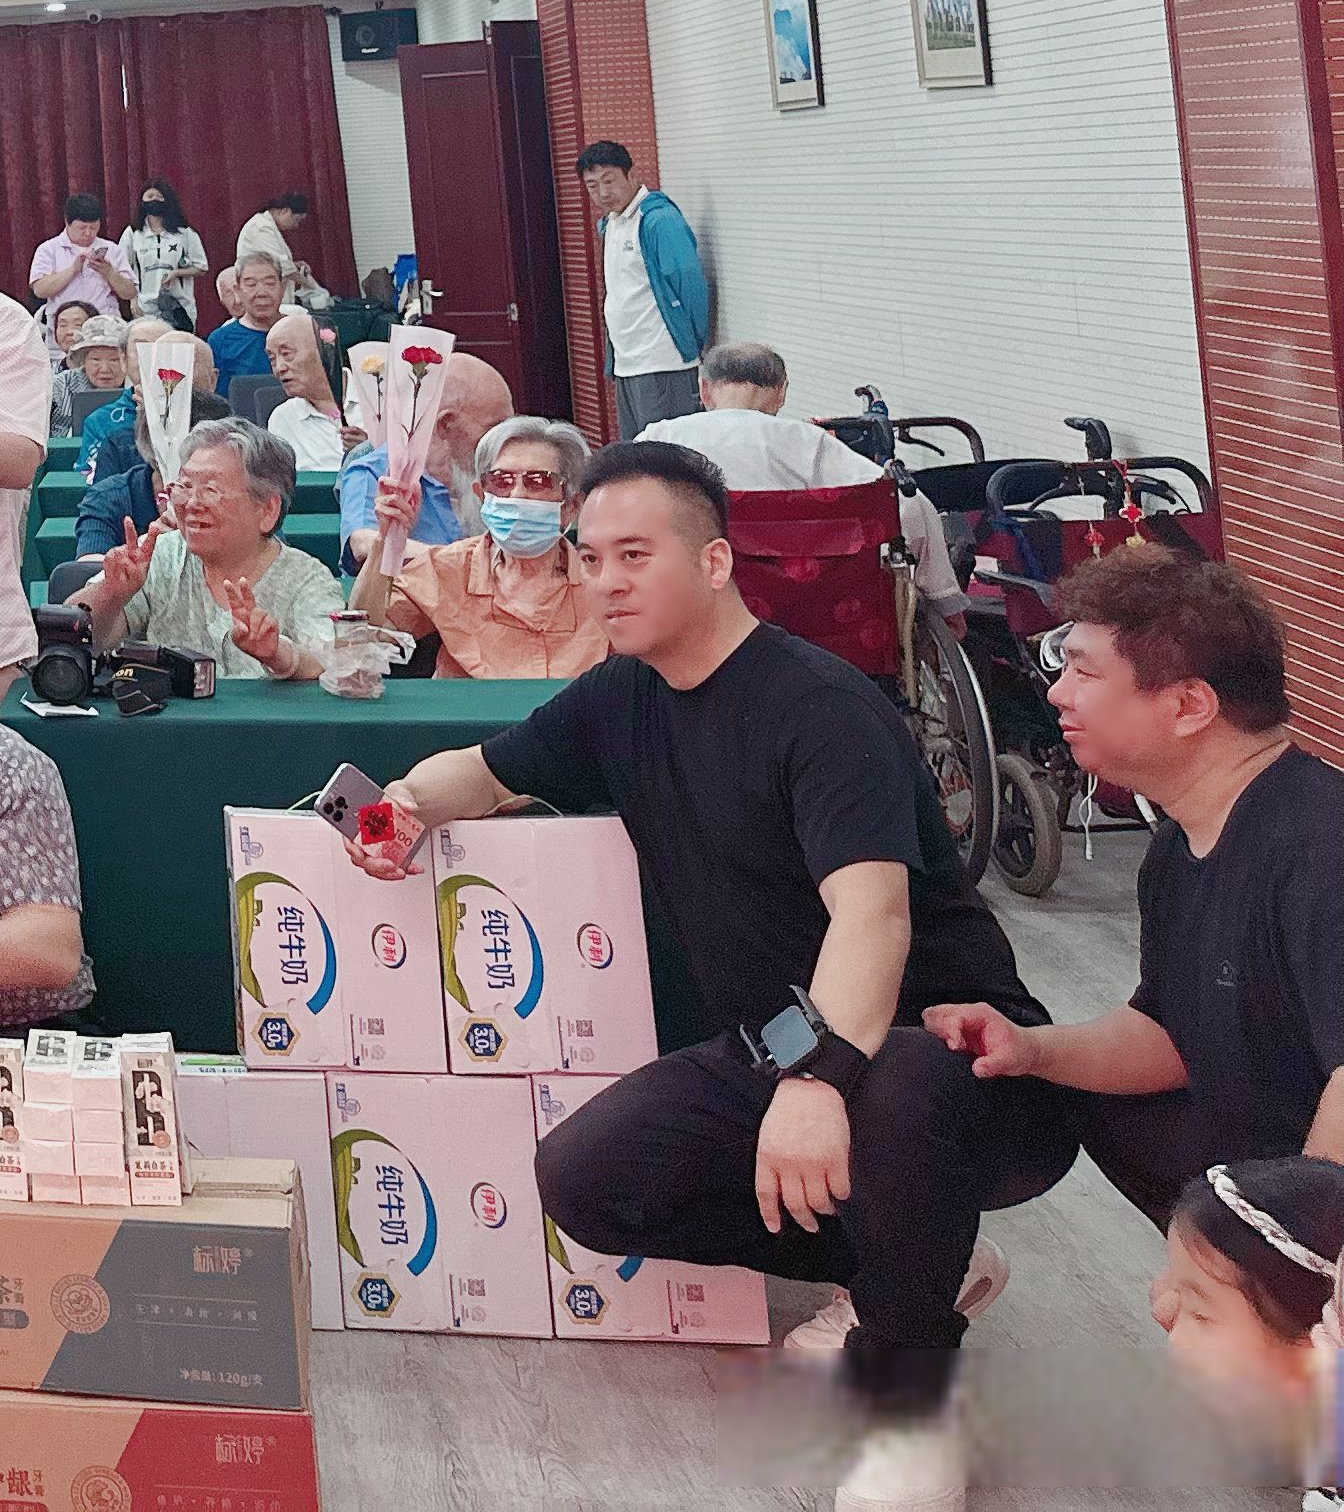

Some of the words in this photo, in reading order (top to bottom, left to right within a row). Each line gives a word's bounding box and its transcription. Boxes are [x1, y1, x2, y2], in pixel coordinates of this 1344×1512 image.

[395, 829, 413, 847] 100
[277, 906, 309, 985] 纯牛奶
[382, 929, 397, 963] 伊利
[481, 908, 516, 989] 纯牛奶
[587, 929, 604, 963] 伊利
[375, 1164, 409, 1245] 纯牛奶
[481, 1188, 498, 1223] 伊利
